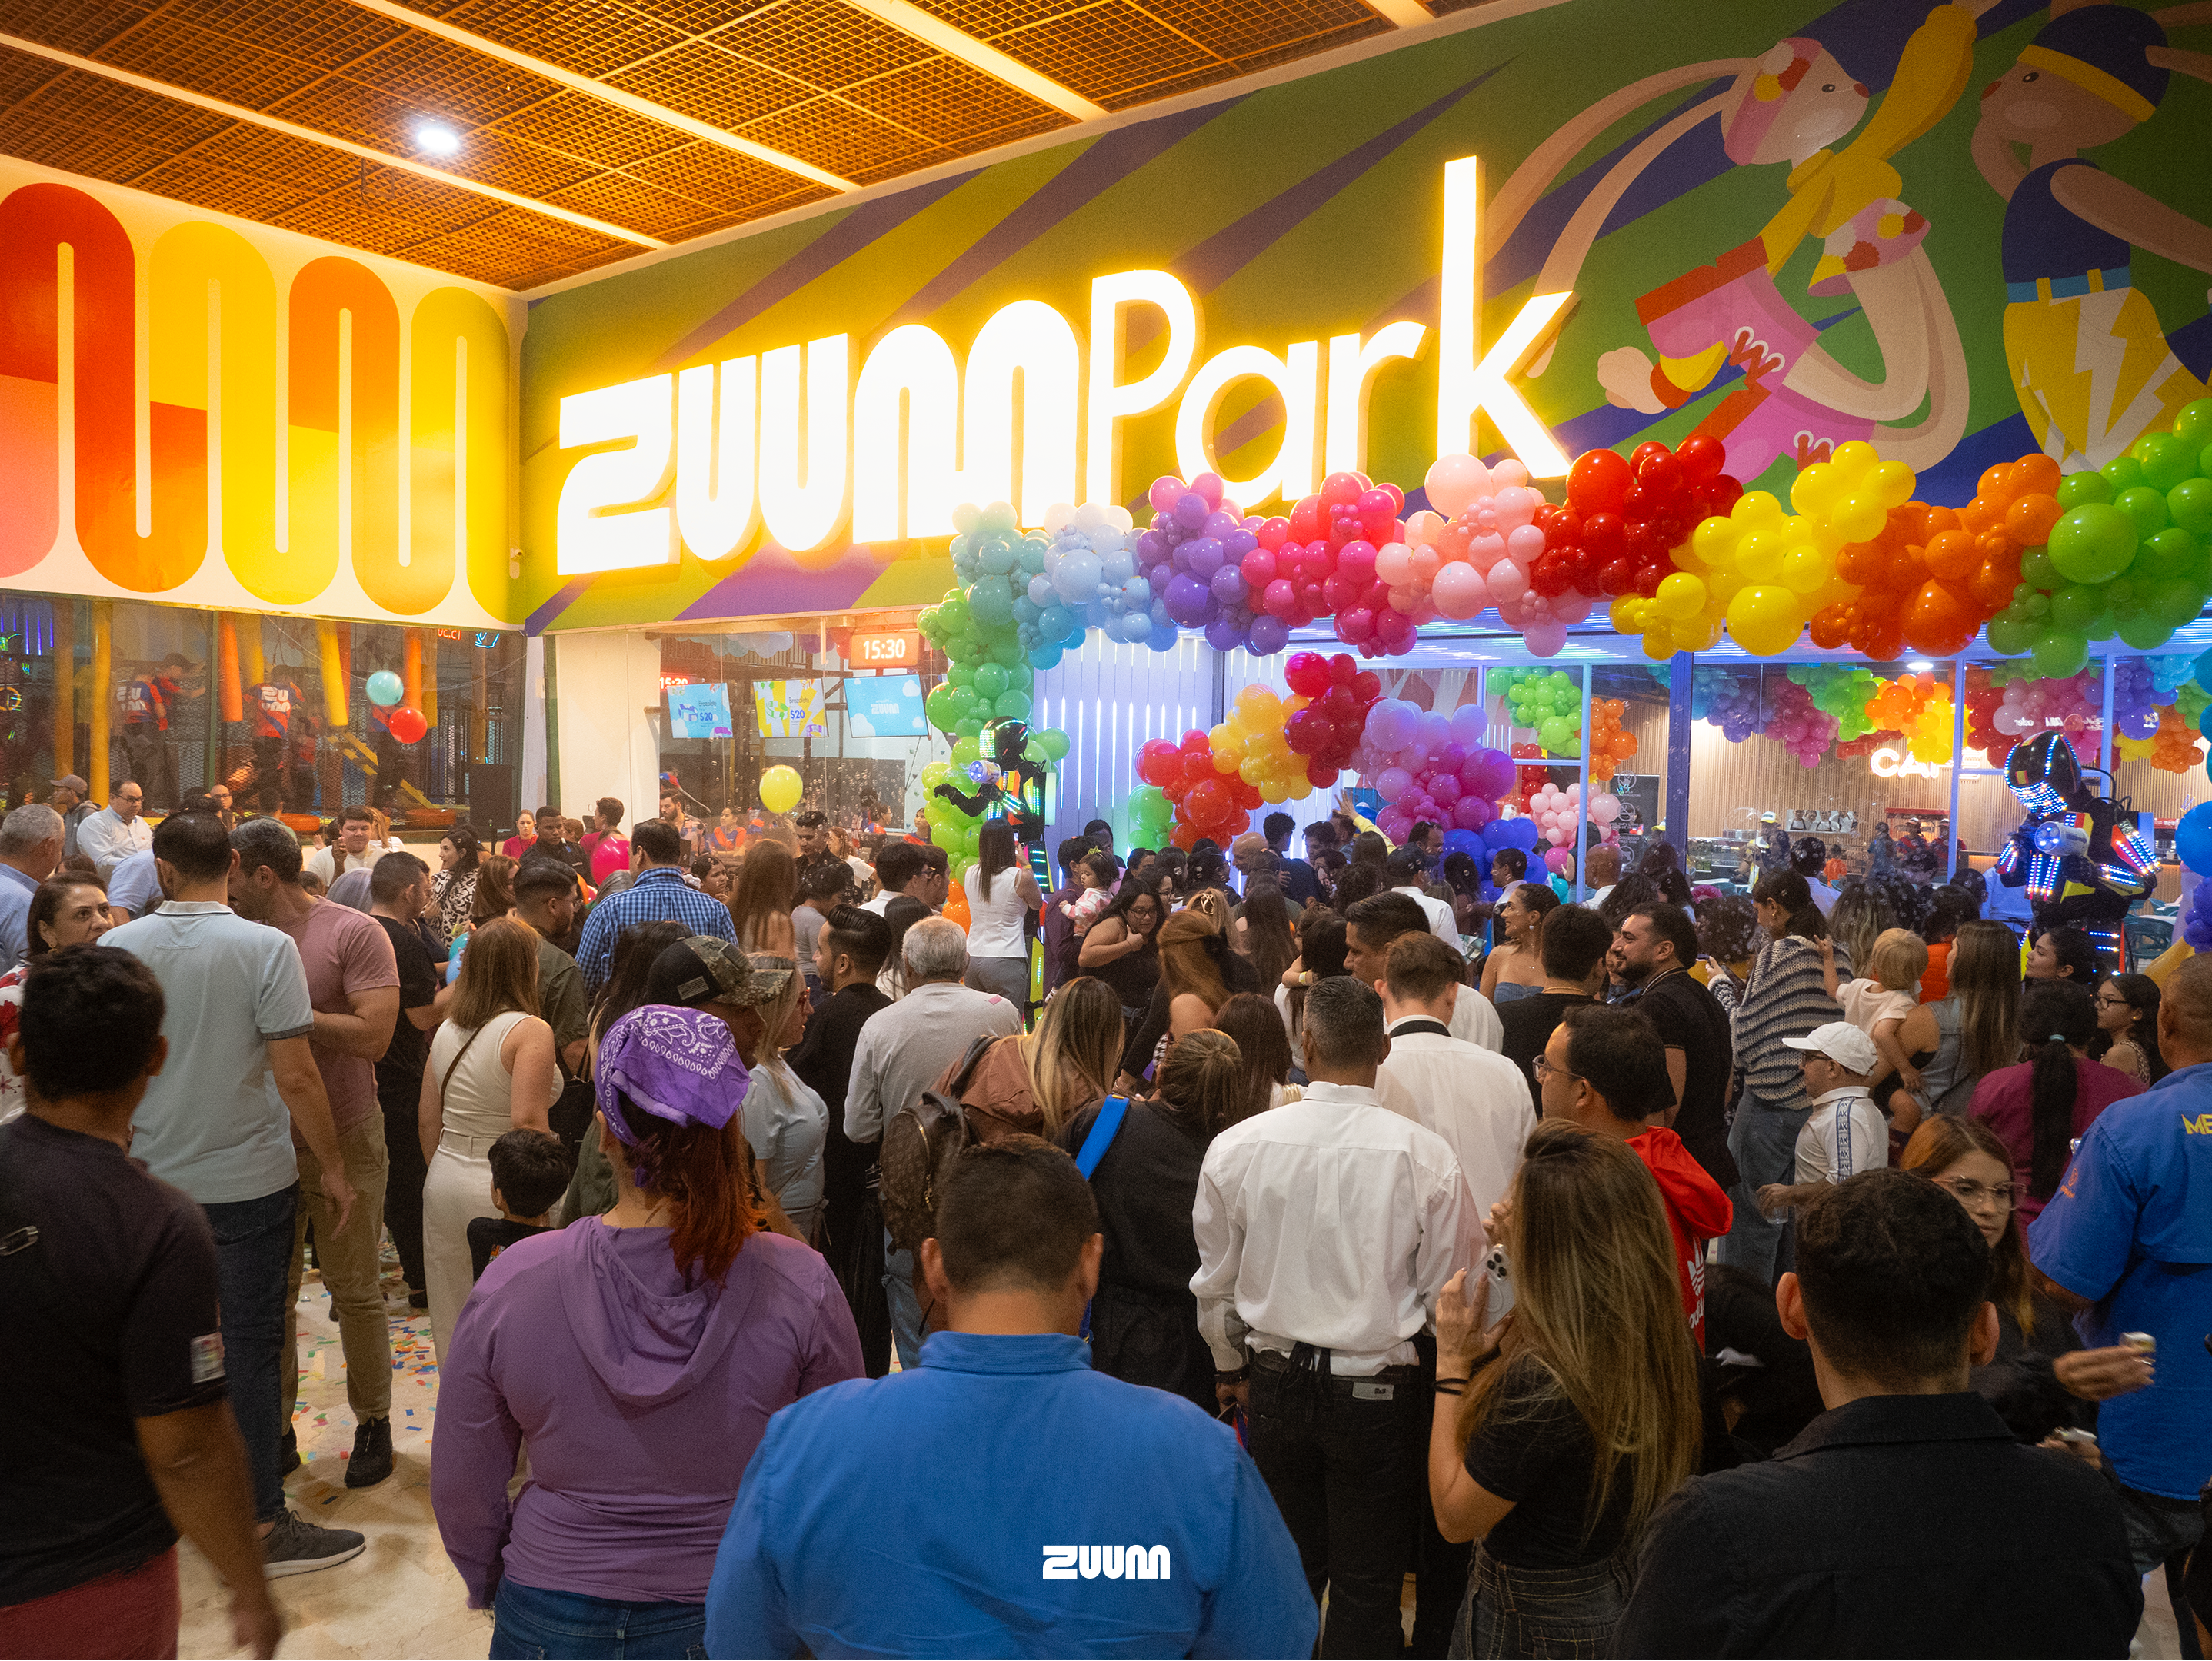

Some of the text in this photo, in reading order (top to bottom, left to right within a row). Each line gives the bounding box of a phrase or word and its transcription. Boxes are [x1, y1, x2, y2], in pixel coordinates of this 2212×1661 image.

[863, 638, 906, 660] 15:30
[699, 712, 713, 721] $20
[790, 709, 805, 720] $20
[2181, 1113, 2212, 1135] ME
